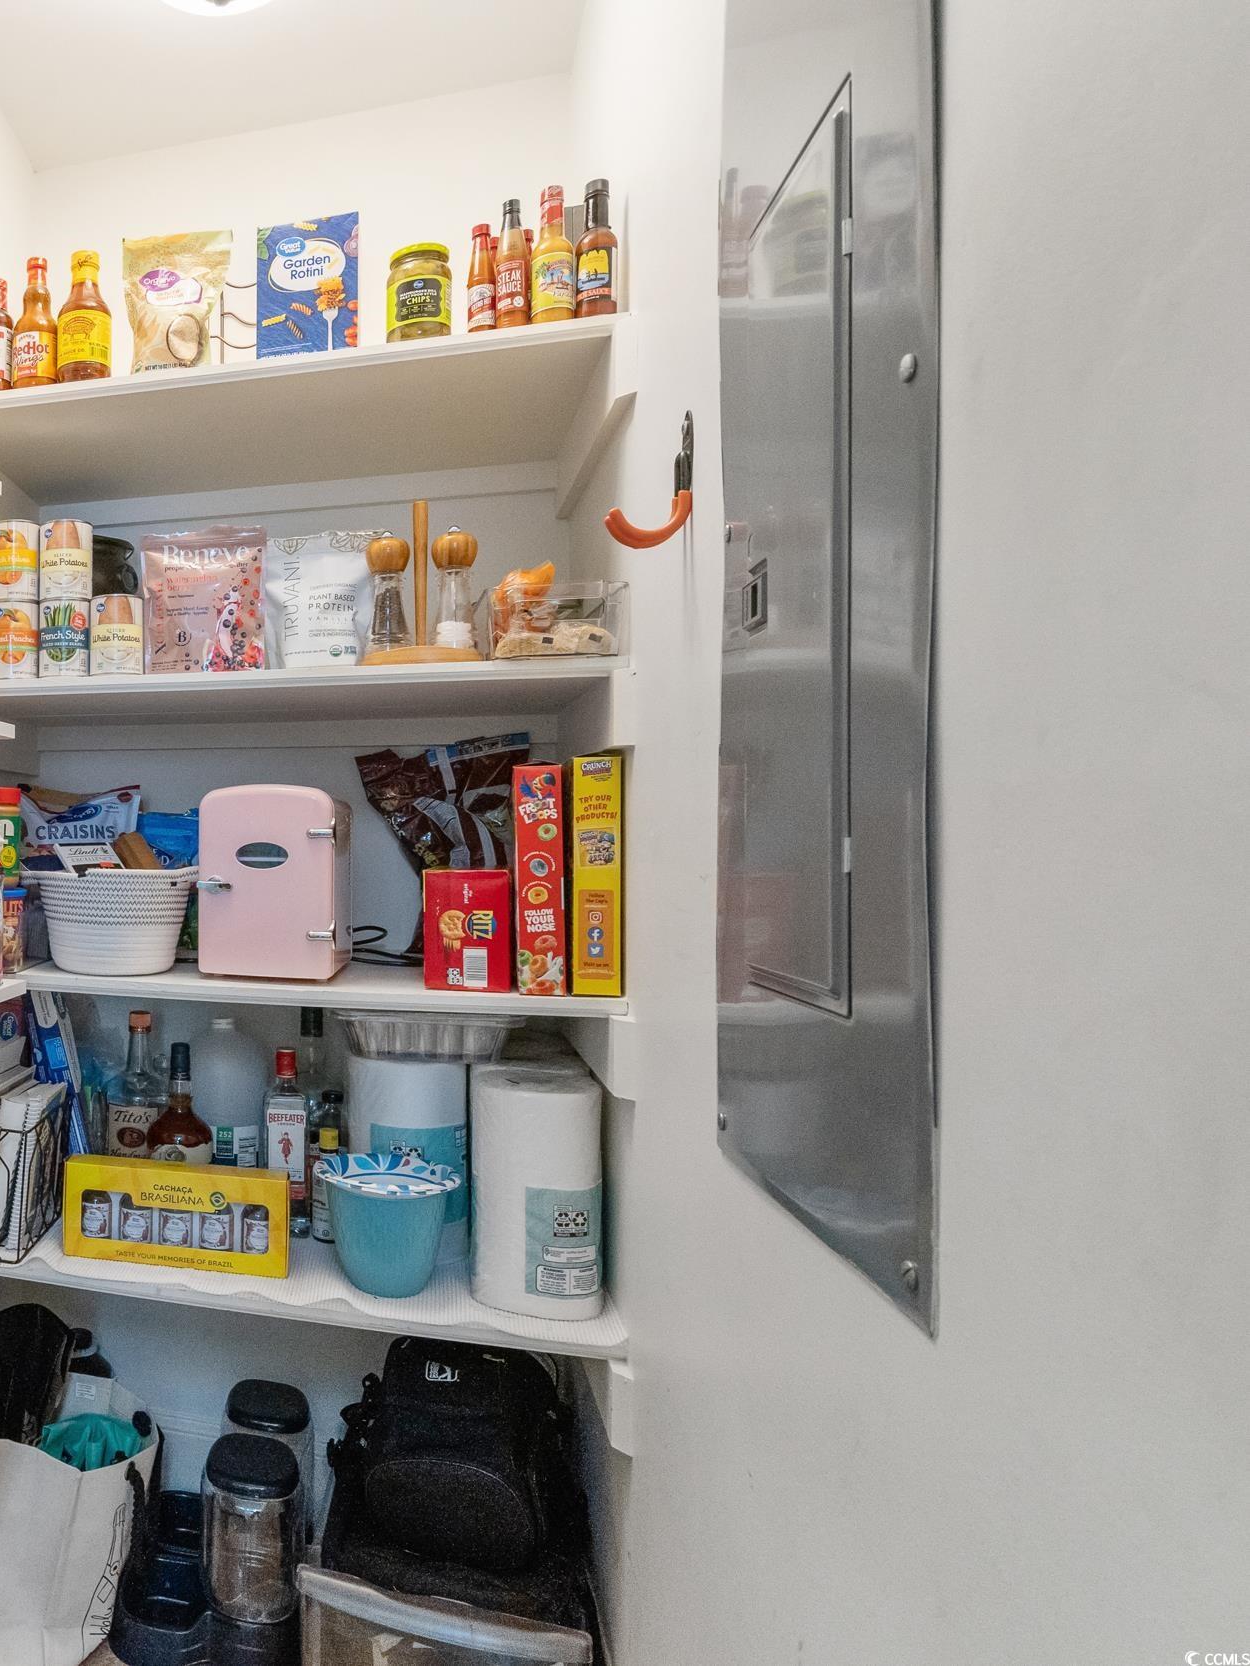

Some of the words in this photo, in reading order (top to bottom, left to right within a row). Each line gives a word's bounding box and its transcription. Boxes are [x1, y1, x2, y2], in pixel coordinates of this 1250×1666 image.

[283, 254, 331, 270] Garden
[290, 265, 324, 280] Rotini
[497, 269, 521, 284] STEAK
[497, 280, 522, 297] SAUCE
[406, 295, 431, 305] CHIPS
[59, 557, 89, 568] Potatoes
[284, 560, 300, 641] TRUVANI
[308, 593, 333, 602] PLANT
[334, 592, 356, 602] BASED
[308, 601, 354, 612] PROTEIN
[40, 631, 64, 641] French
[65, 630, 86, 641] Style
[112, 634, 141, 643] Potatoes
[582, 760, 612, 771] CRUNCH
[579, 795, 594, 805] TRY
[595, 794, 612, 802] OUR
[518, 797, 556, 817] FROOT
[583, 803, 608, 812] OTHER
[523, 808, 558, 825] LOOPS
[575, 812, 618, 823] PRODUCTS!
[35, 824, 116, 841] CRAISINS
[69, 846, 101, 857] Lindt
[524, 907, 554, 917] FOLLOW
[472, 910, 494, 940] RITZ
[525, 914, 555, 925] YOUR
[526, 922, 557, 933] NOSE
[113, 1110, 152, 1124] Tito's
[268, 1112, 306, 1126] BEEFEATER
[218, 1130, 232, 1138] 252
[153, 1183, 193, 1195] CACHAÇA
[140, 1191, 205, 1207] BRASILIANA
[116, 1249, 136, 1258] TASTE
[136, 1250, 157, 1260] YOUR
[157, 1255, 196, 1265] MEMORIES
[196, 1258, 206, 1266] OF
[207, 1259, 234, 1269] BRAZIL
